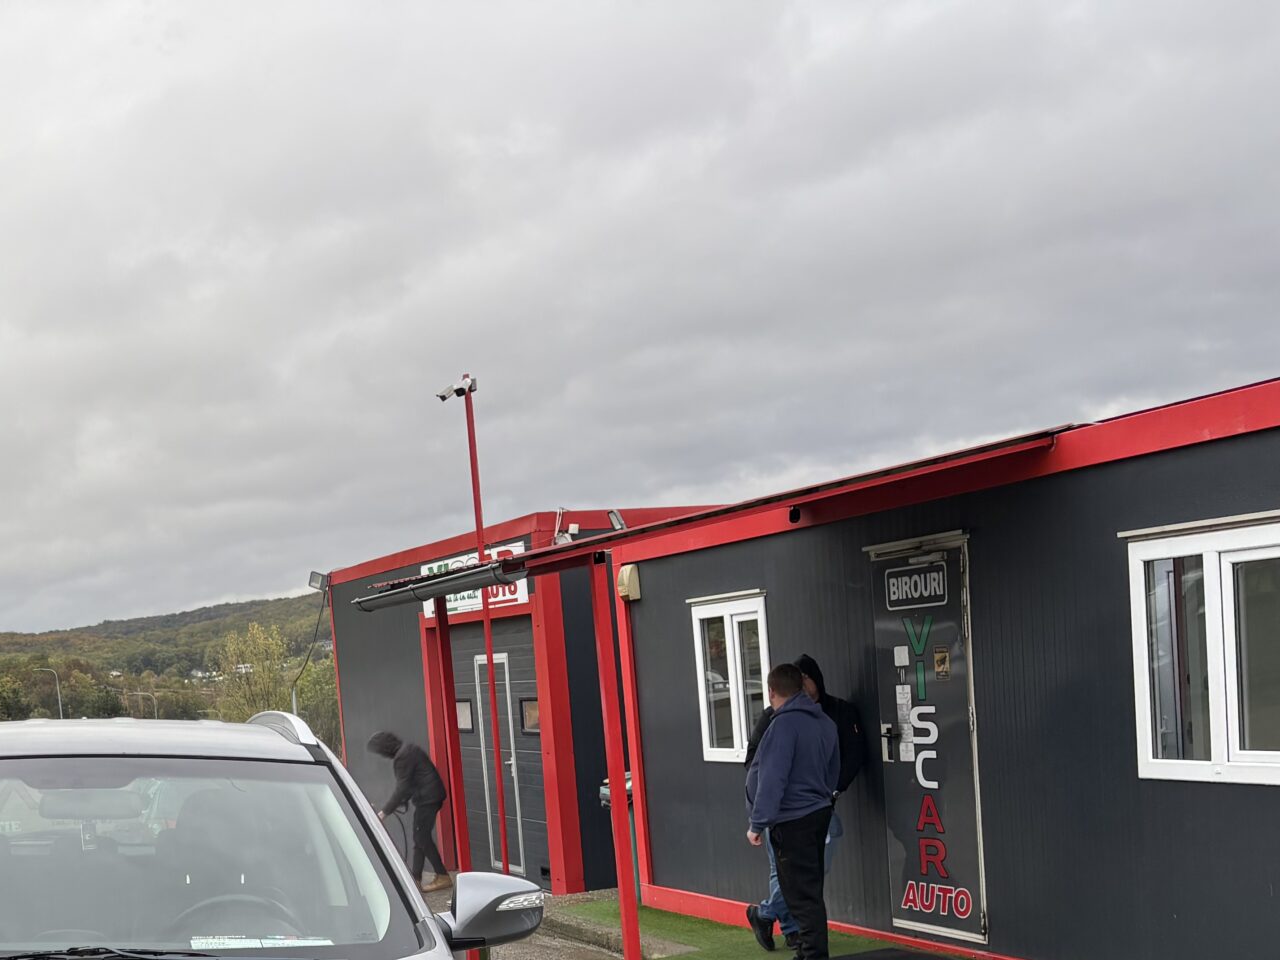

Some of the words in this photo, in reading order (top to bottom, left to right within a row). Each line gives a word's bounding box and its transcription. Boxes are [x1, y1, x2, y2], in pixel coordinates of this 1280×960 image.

[888, 571, 944, 600] BIROURI
[902, 614, 949, 878] VISCAR
[901, 880, 973, 919] AUTO
